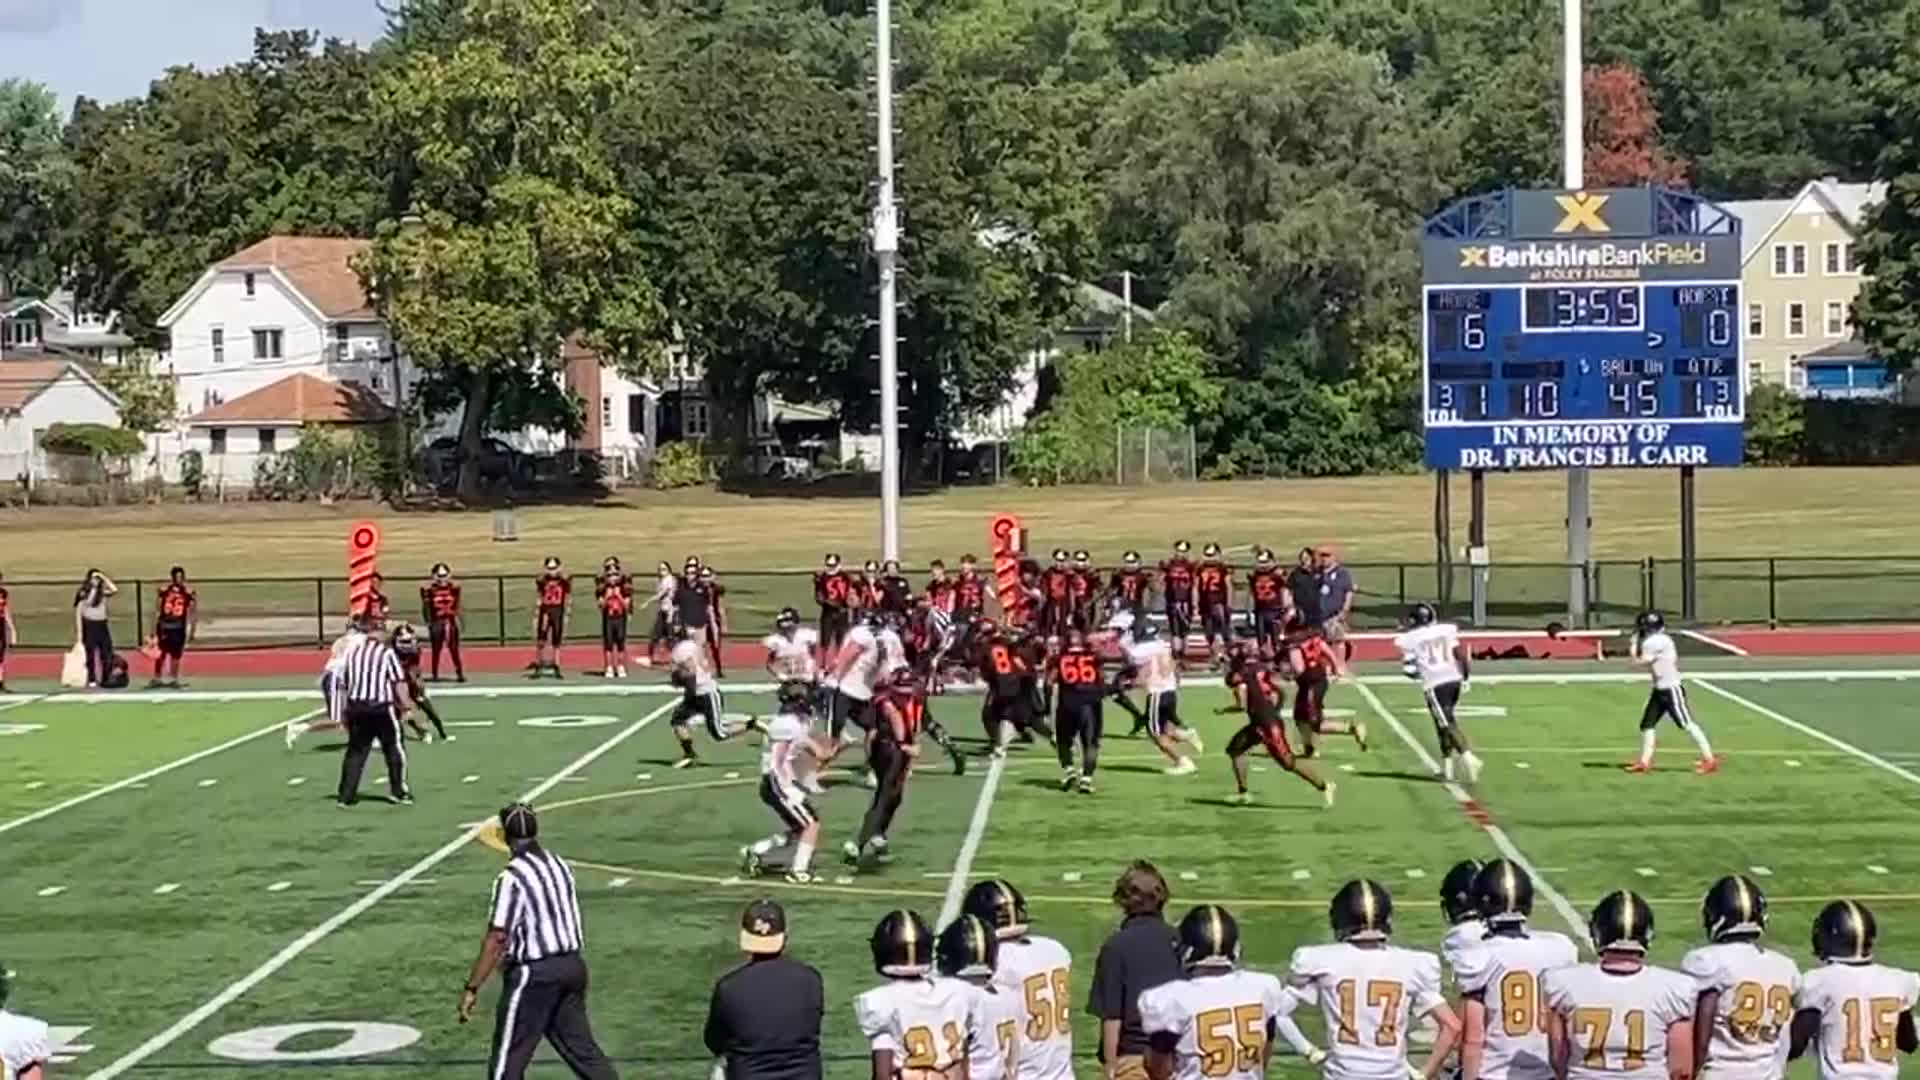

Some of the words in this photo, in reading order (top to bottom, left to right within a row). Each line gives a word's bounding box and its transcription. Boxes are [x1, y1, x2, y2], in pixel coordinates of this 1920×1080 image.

[1488, 243, 1706, 268] BerkshireBankField
[1557, 289, 1638, 326] 3:55
[1464, 314, 1485, 350] 6
[1709, 310, 1730, 345] 0
[1440, 384, 1453, 407] 3
[1480, 384, 1488, 415] 1
[1524, 381, 1558, 417] 10
[1609, 379, 1658, 416] 45
[1695, 381, 1702, 412] 1
[1717, 380, 1729, 402] 3
[1493, 426, 1518, 445] IN
[1523, 424, 1633, 444] MEMORY
[1636, 423, 1671, 443] OF
[1460, 448, 1499, 468] DR.
[1504, 447, 1607, 467] FRANCIS
[1612, 447, 1635, 466] H.
[1639, 445, 1709, 465] CARR
[1060, 655, 1097, 683] 66
[1336, 979, 1402, 1046] 17
[1842, 996, 1903, 1063] 15
[1196, 1003, 1264, 1078] 55
[1573, 1008, 1648, 1070] 71
